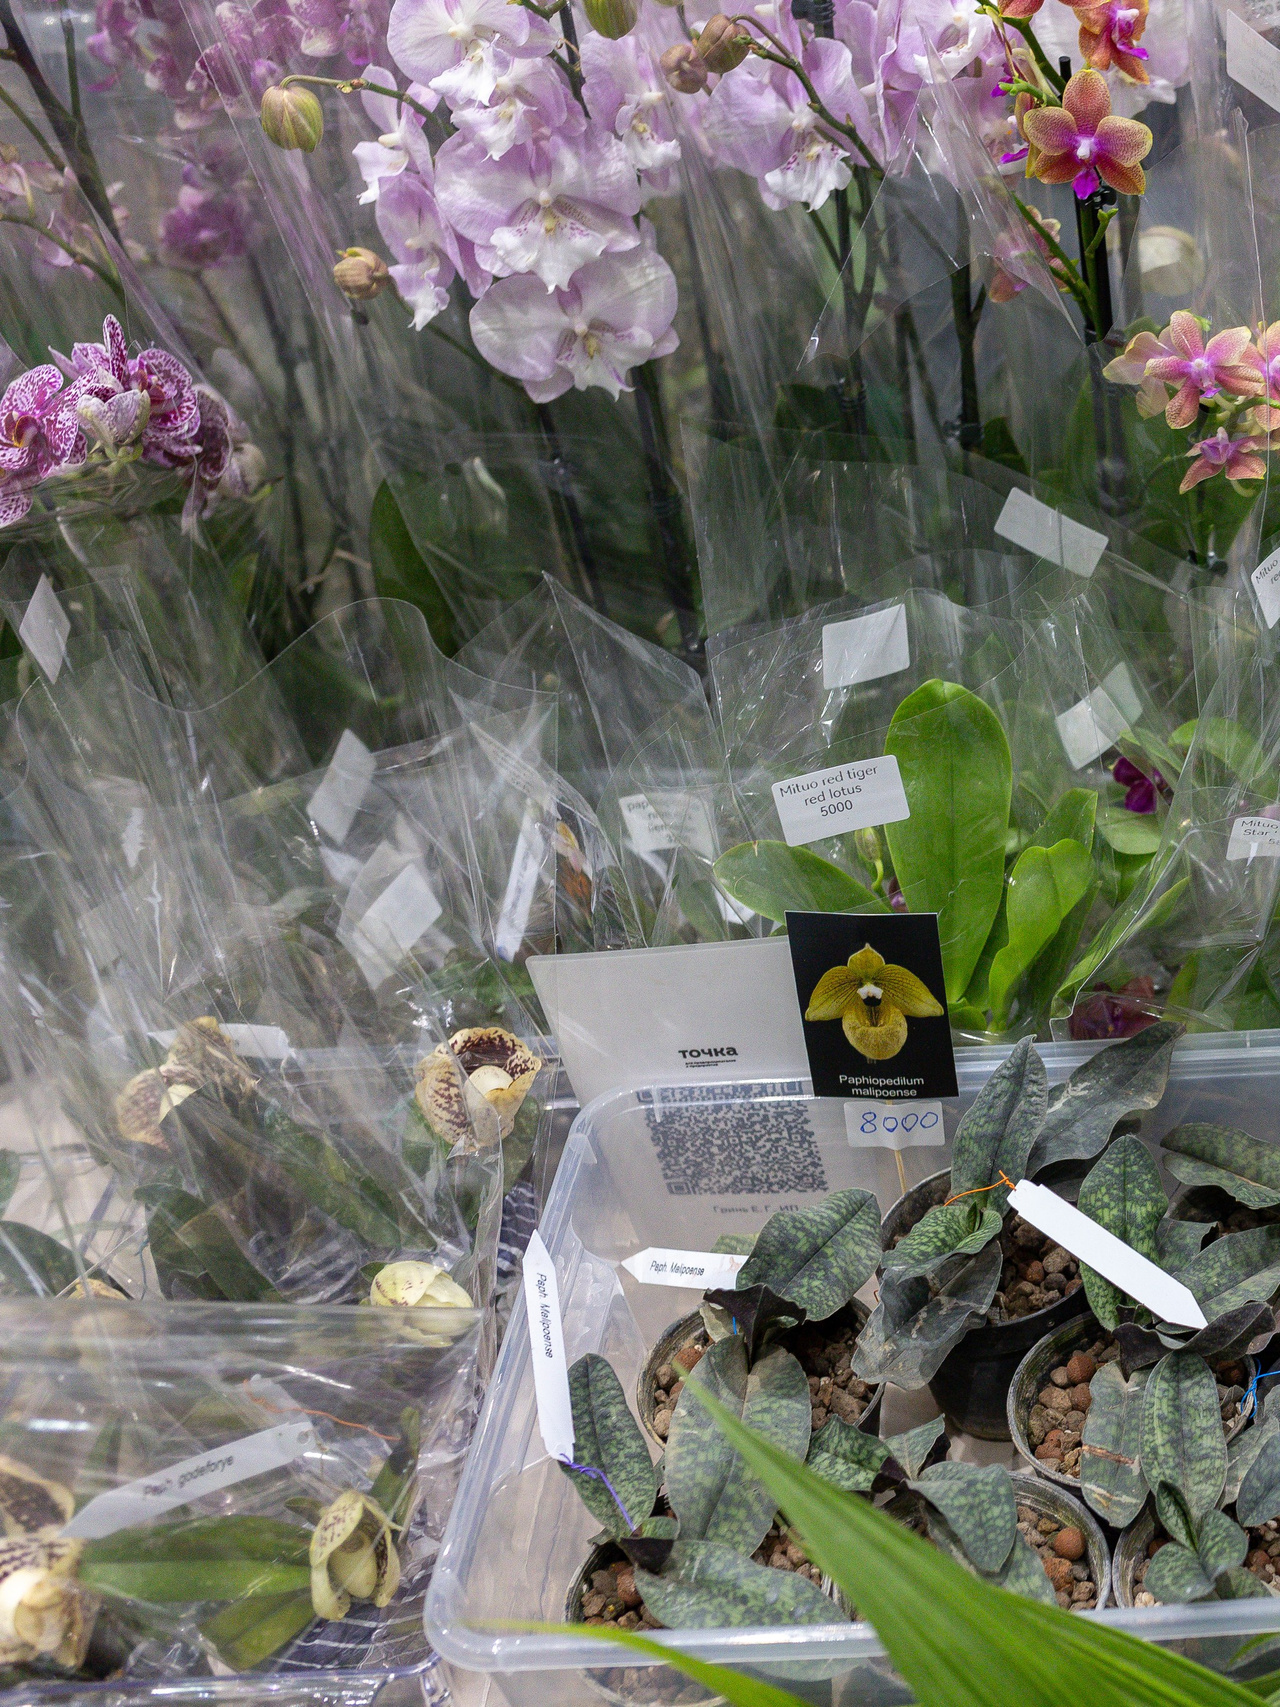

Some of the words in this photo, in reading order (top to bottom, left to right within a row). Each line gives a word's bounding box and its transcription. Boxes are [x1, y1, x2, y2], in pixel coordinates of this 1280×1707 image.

[1255, 560, 1278, 584] Mituo
[779, 780, 819, 798] Mituo
[822, 771, 844, 786] red
[847, 765, 878, 780] tiger
[804, 791, 826, 806] red
[829, 784, 862, 799] lotus
[820, 799, 853, 817] 5000
[1241, 820, 1279, 830] Mituo
[1243, 828, 1270, 836] Star
[678, 1046, 739, 1059] точка
[838, 1074, 925, 1087] Paphiopedilum
[851, 1087, 918, 1098] malipoense
[860, 1111, 939, 1134] 8000
[649, 1260, 668, 1276] Paph.
[669, 1261, 705, 1277] Malipoense
[540, 1302, 553, 1358] Malipoense
